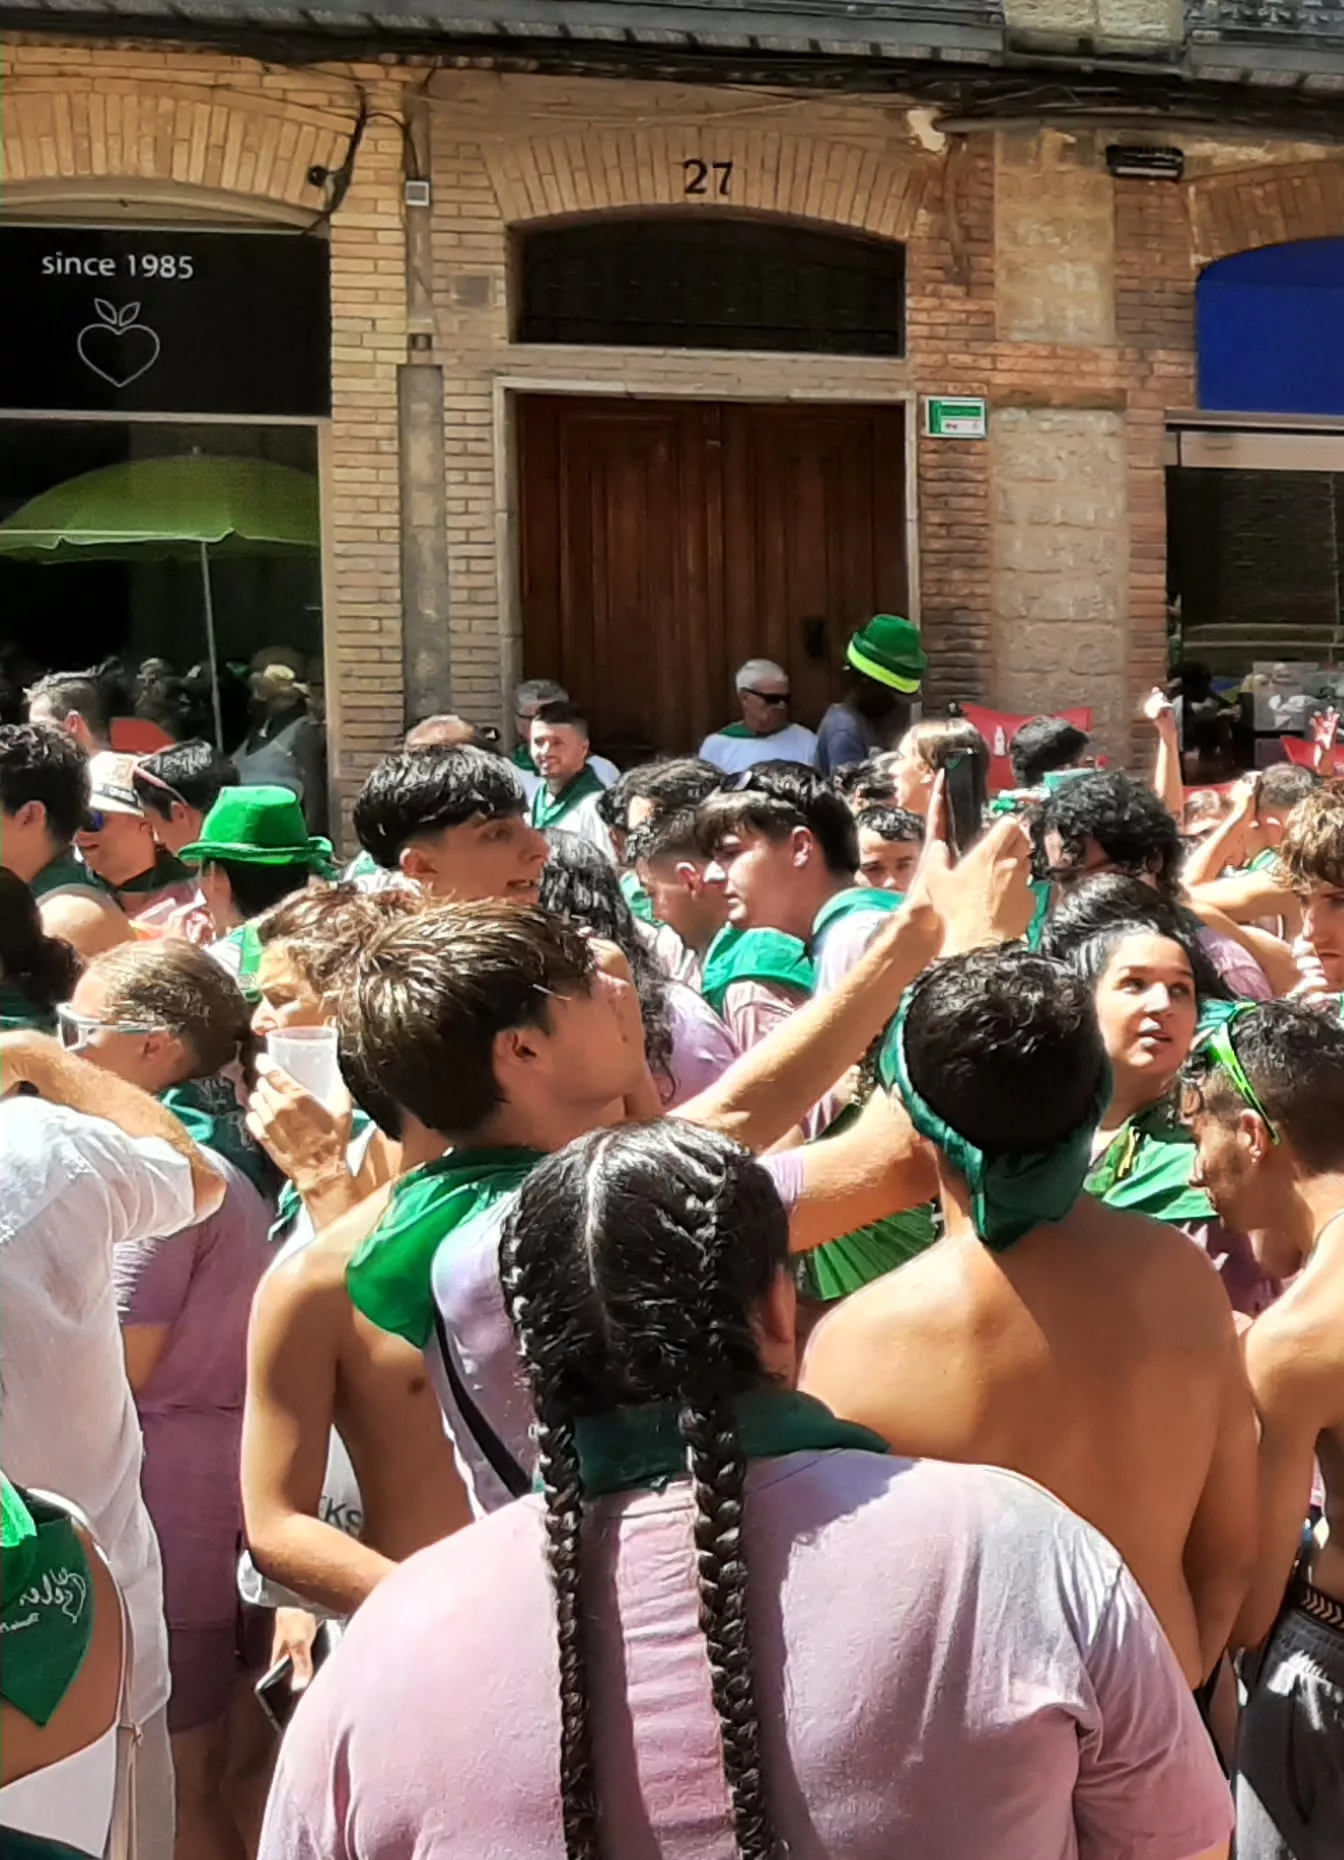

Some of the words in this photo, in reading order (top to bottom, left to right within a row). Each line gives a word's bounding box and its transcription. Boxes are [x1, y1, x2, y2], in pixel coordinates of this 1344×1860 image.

[683, 159, 733, 195] 27
[41, 251, 116, 276] since
[127, 254, 194, 279] 1985
